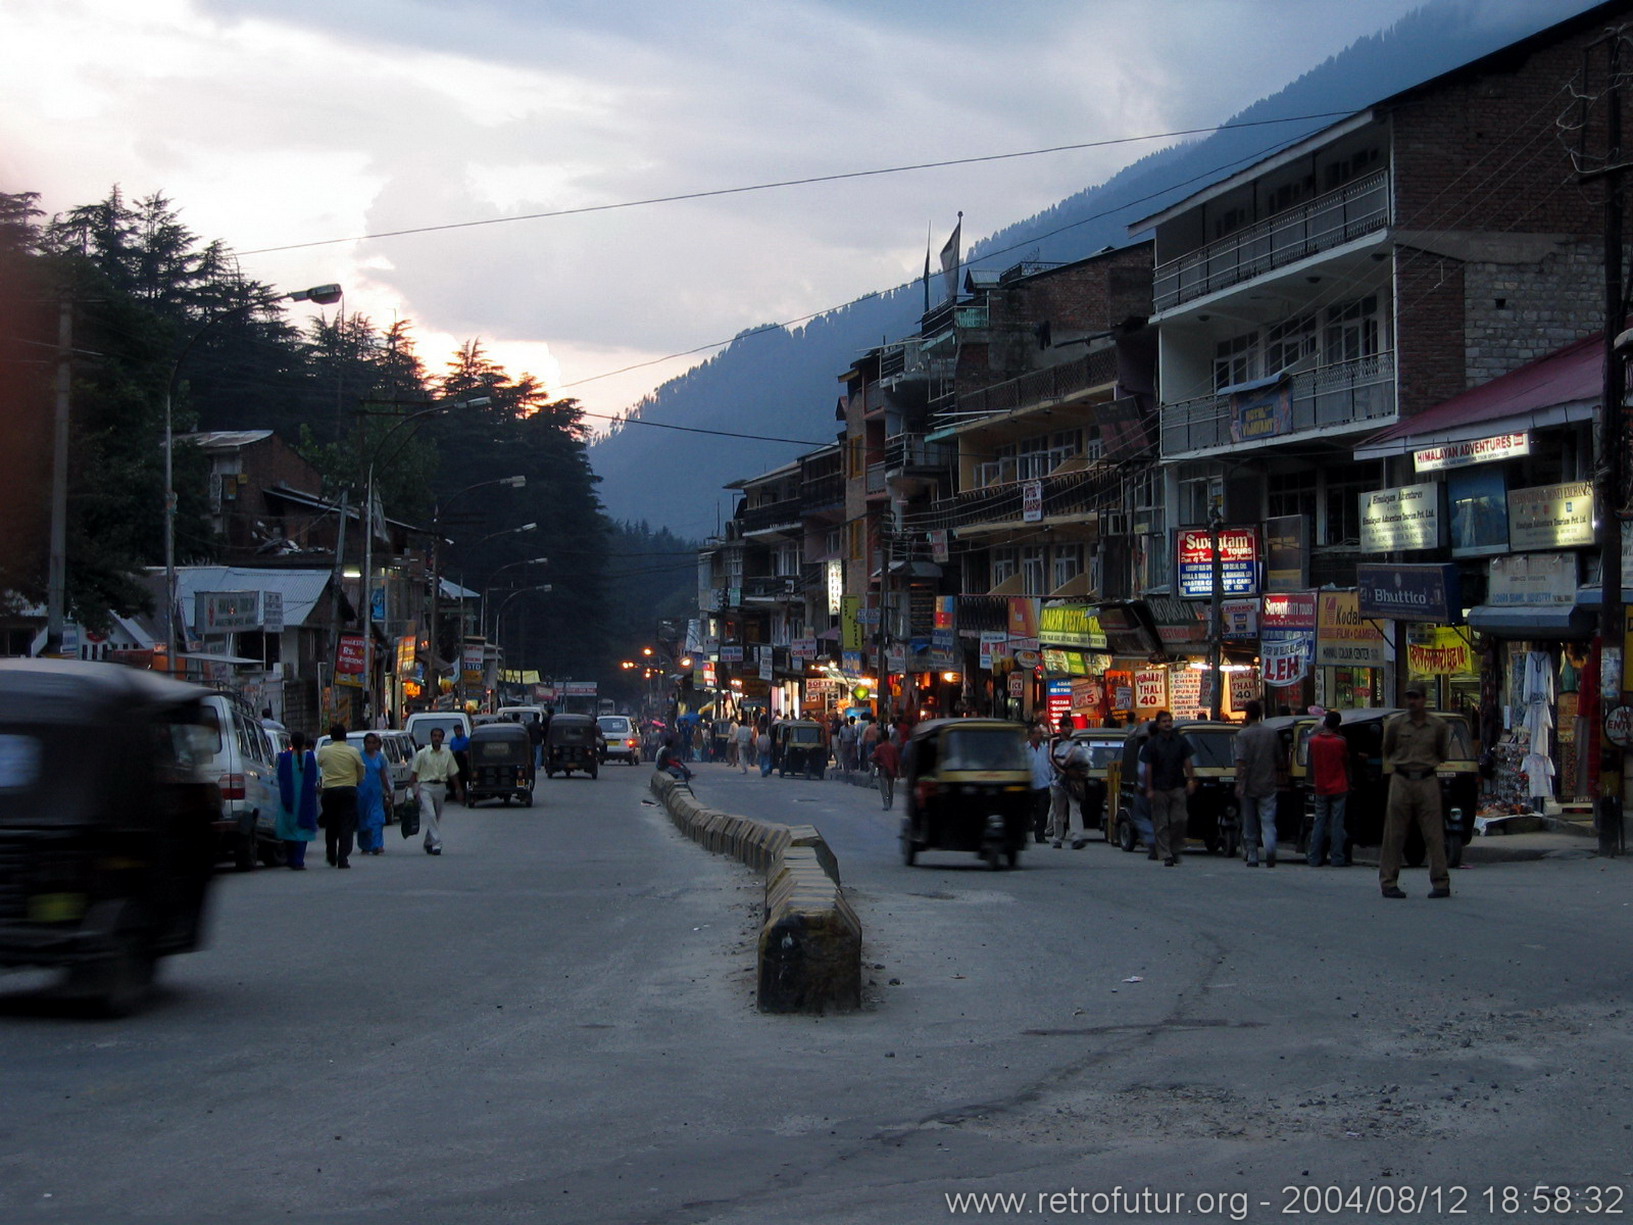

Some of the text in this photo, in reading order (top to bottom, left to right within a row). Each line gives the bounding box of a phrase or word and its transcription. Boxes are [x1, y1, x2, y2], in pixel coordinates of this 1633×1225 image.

[1417, 446, 1458, 463] HIMALAYAN
[1460, 436, 1512, 456] ADVENTURES
[1227, 547, 1252, 555] TOURS
[1374, 588, 1426, 605] Bhuttico
[1264, 656, 1299, 681] LEH
[1136, 673, 1163, 685] PUNJABI
[1139, 685, 1162, 695] THALI
[1236, 690, 1251, 699] 40
[1086, 694, 1095, 704] 5
[1140, 695, 1157, 706] 40
